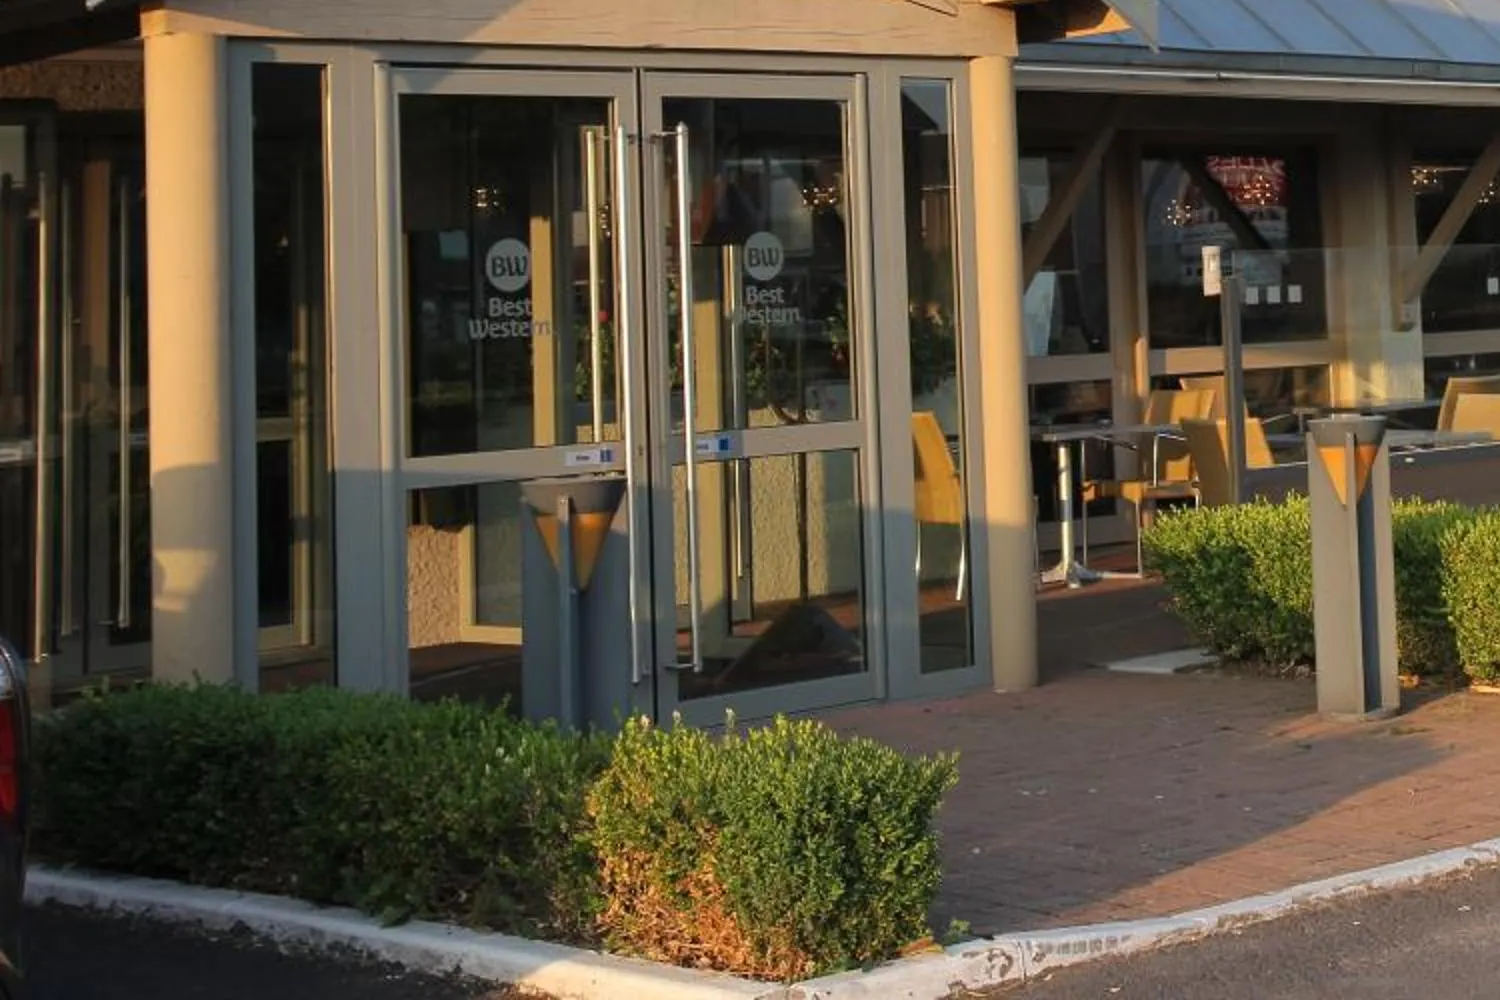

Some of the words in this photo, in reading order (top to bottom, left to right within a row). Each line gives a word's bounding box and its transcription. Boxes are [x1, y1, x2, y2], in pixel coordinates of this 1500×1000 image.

[491, 255, 528, 278] BW
[748, 247, 780, 269] BW
[745, 285, 785, 305] Best
[488, 297, 534, 317] Best
